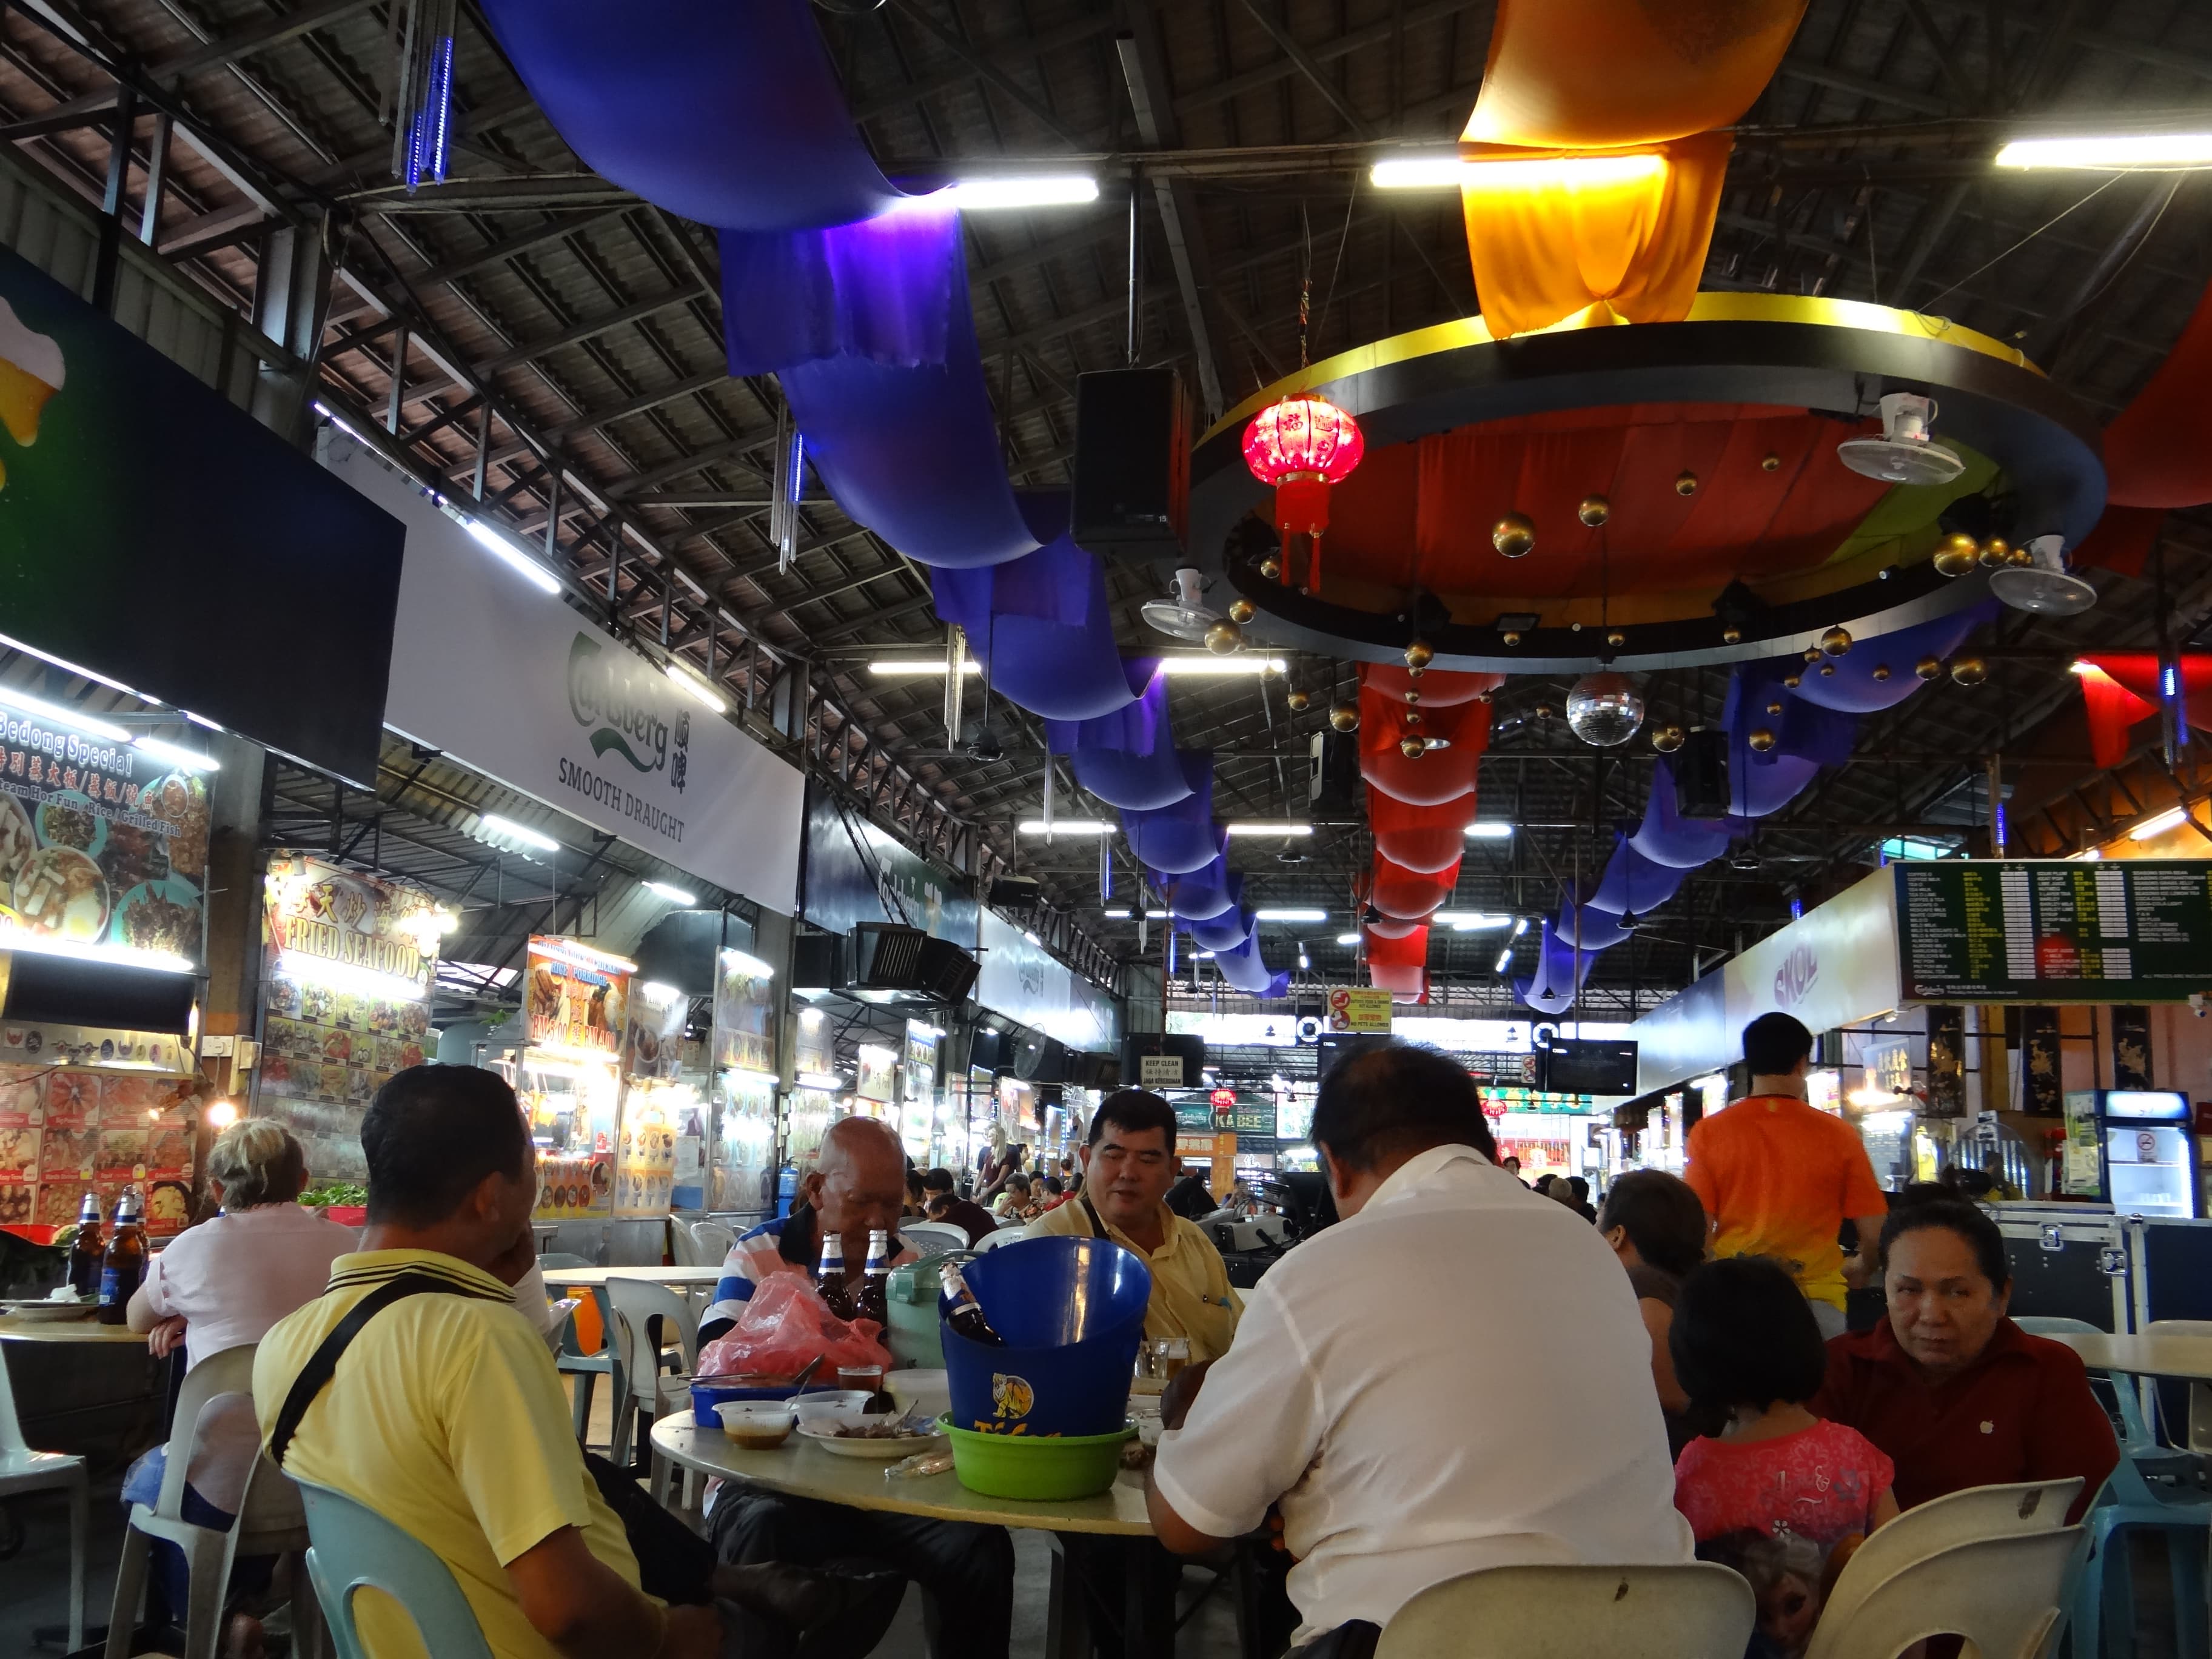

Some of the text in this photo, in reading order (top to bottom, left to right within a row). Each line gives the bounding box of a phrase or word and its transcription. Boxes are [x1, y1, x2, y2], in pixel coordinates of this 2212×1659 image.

[0, 711, 133, 776] Bedong Special
[0, 777, 29, 798] team
[30, 785, 53, 804] Hor
[56, 793, 78, 810] Fun
[89, 802, 113, 819] Rice
[122, 811, 158, 831] Grilled
[160, 819, 181, 837] Fish
[558, 757, 684, 842] SMOOTH DRAUGHT
[285, 915, 420, 979] FRIED SEAFOOD
[551, 961, 568, 976] RICE
[574, 965, 608, 987] PORRIDGE
[1774, 942, 1817, 1008] SKOL
[1236, 1114, 1262, 1128] BEE
